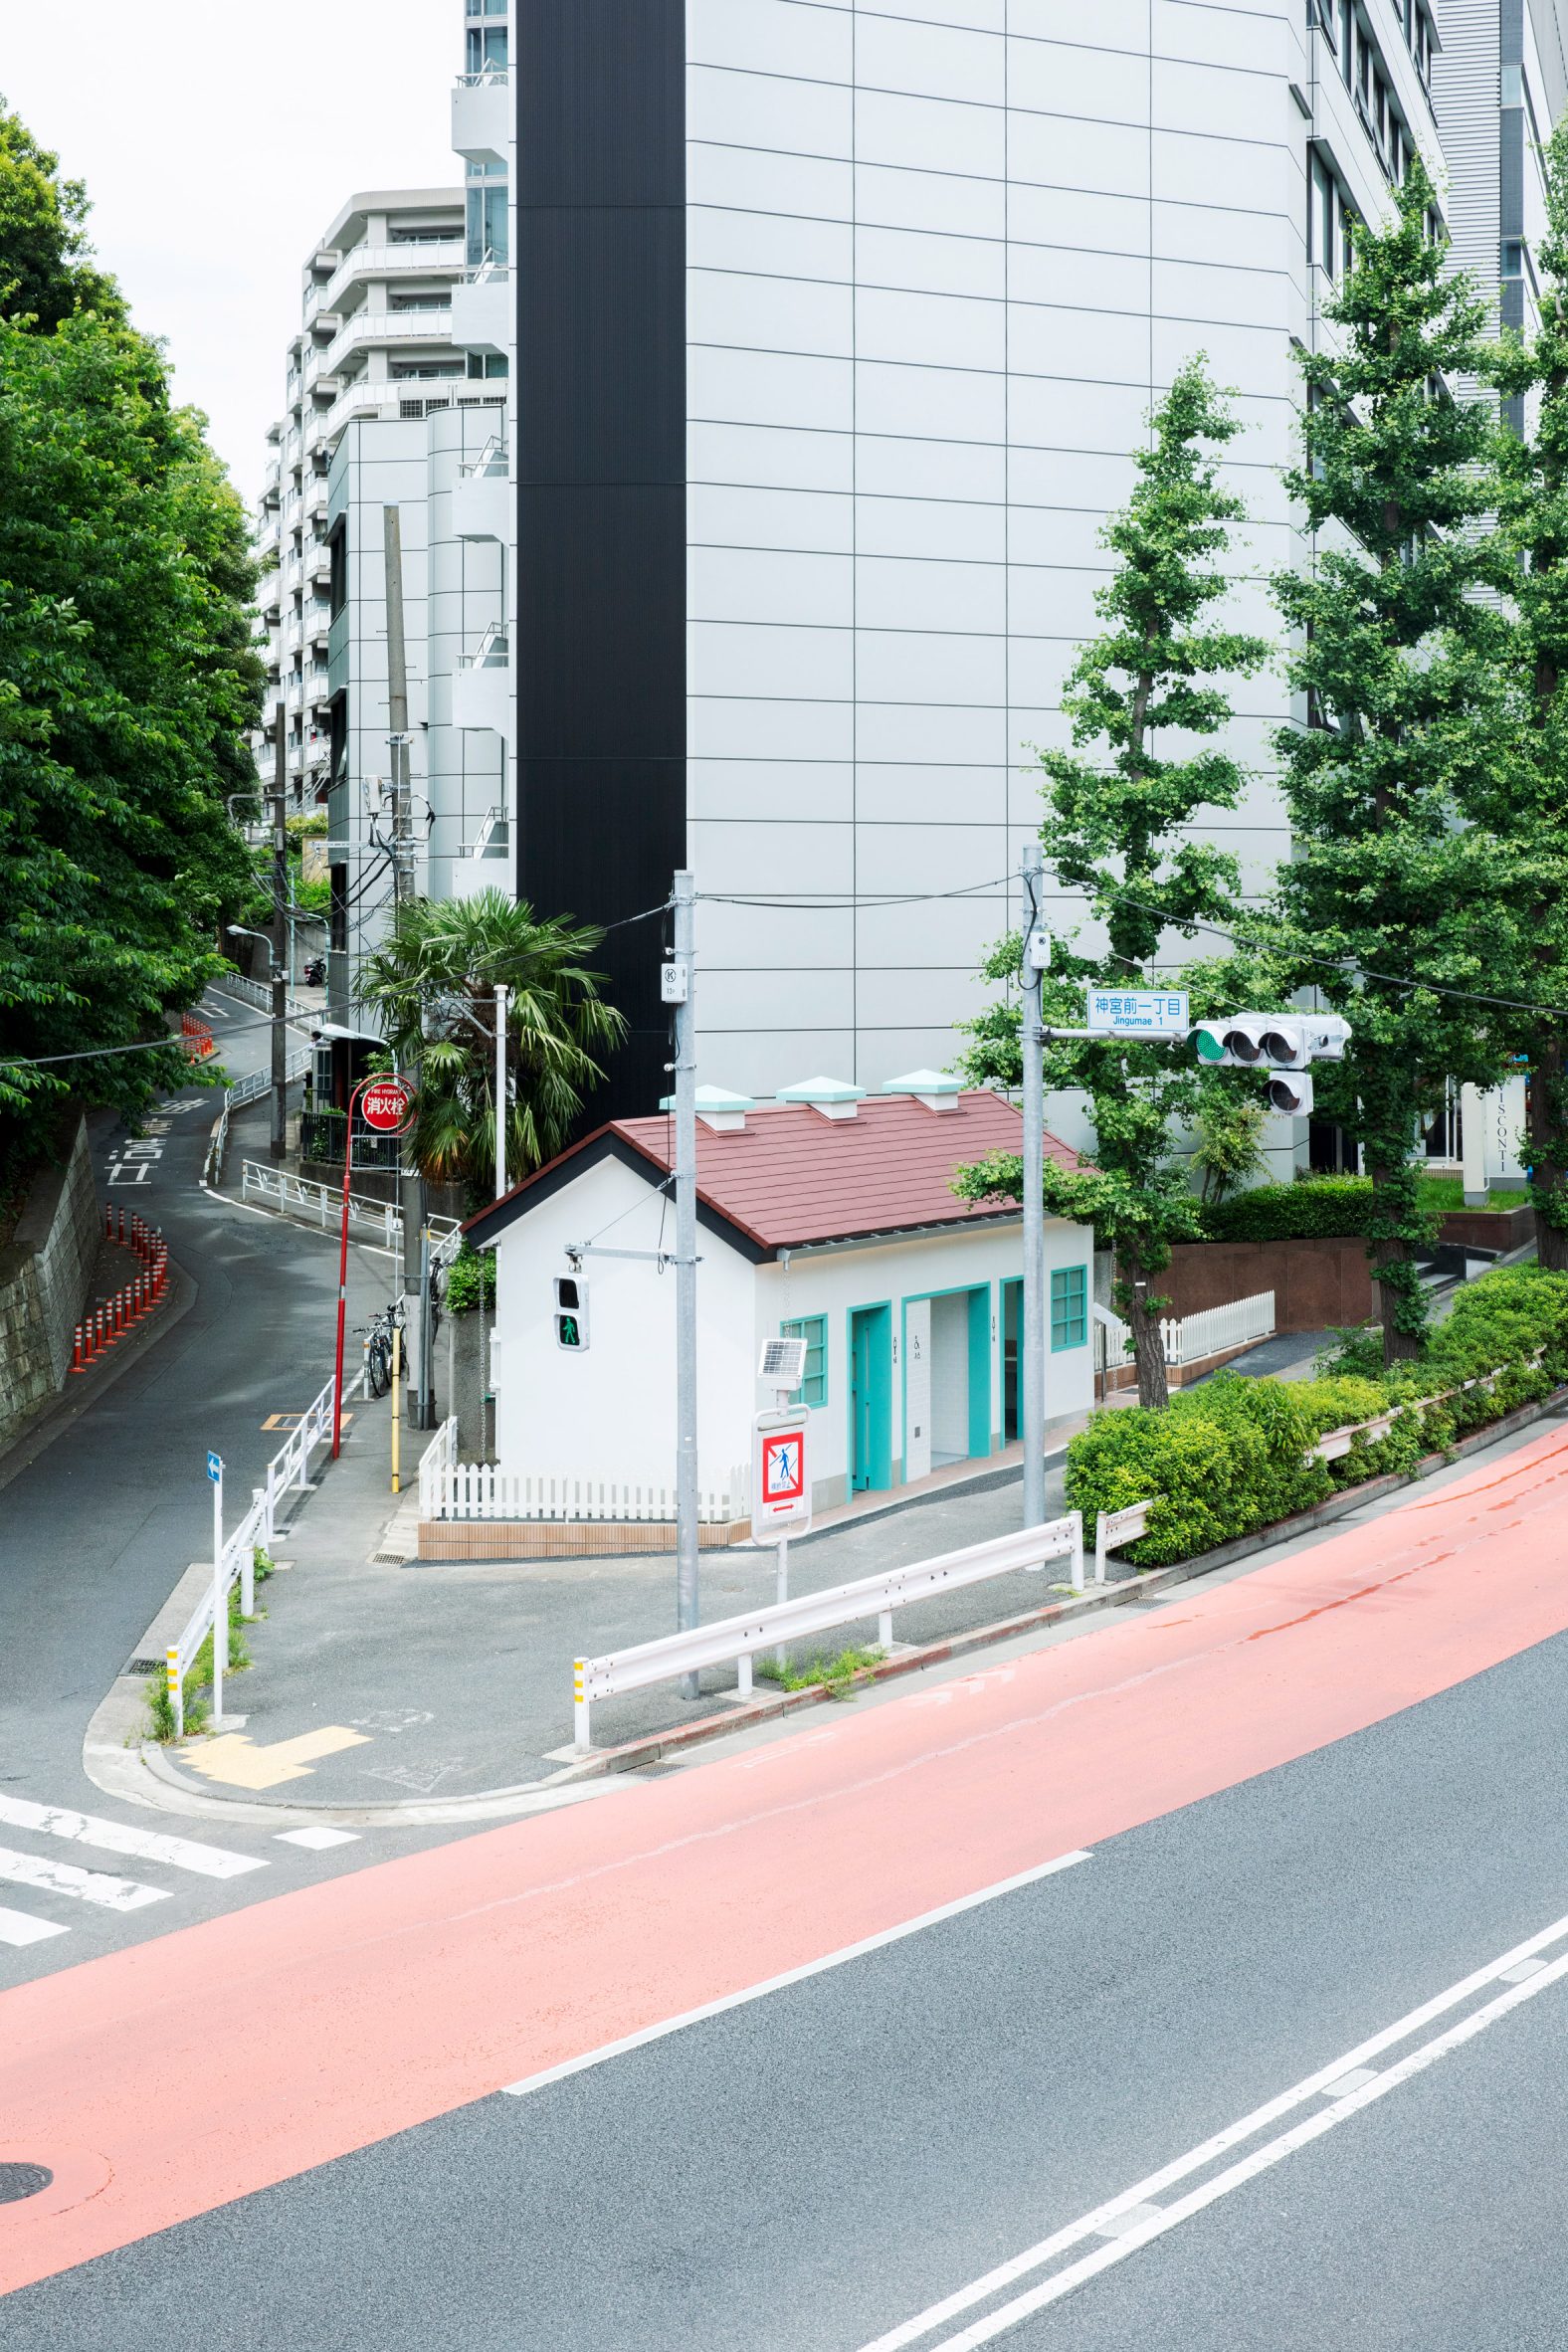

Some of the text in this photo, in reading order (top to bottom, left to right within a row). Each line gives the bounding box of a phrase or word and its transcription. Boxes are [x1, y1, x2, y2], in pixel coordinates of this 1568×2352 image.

[1095, 997, 1180, 1015] 神宮前一丁目
[1113, 1016, 1152, 1026] Jingumae
[367, 1096, 406, 1114] 消火栓
